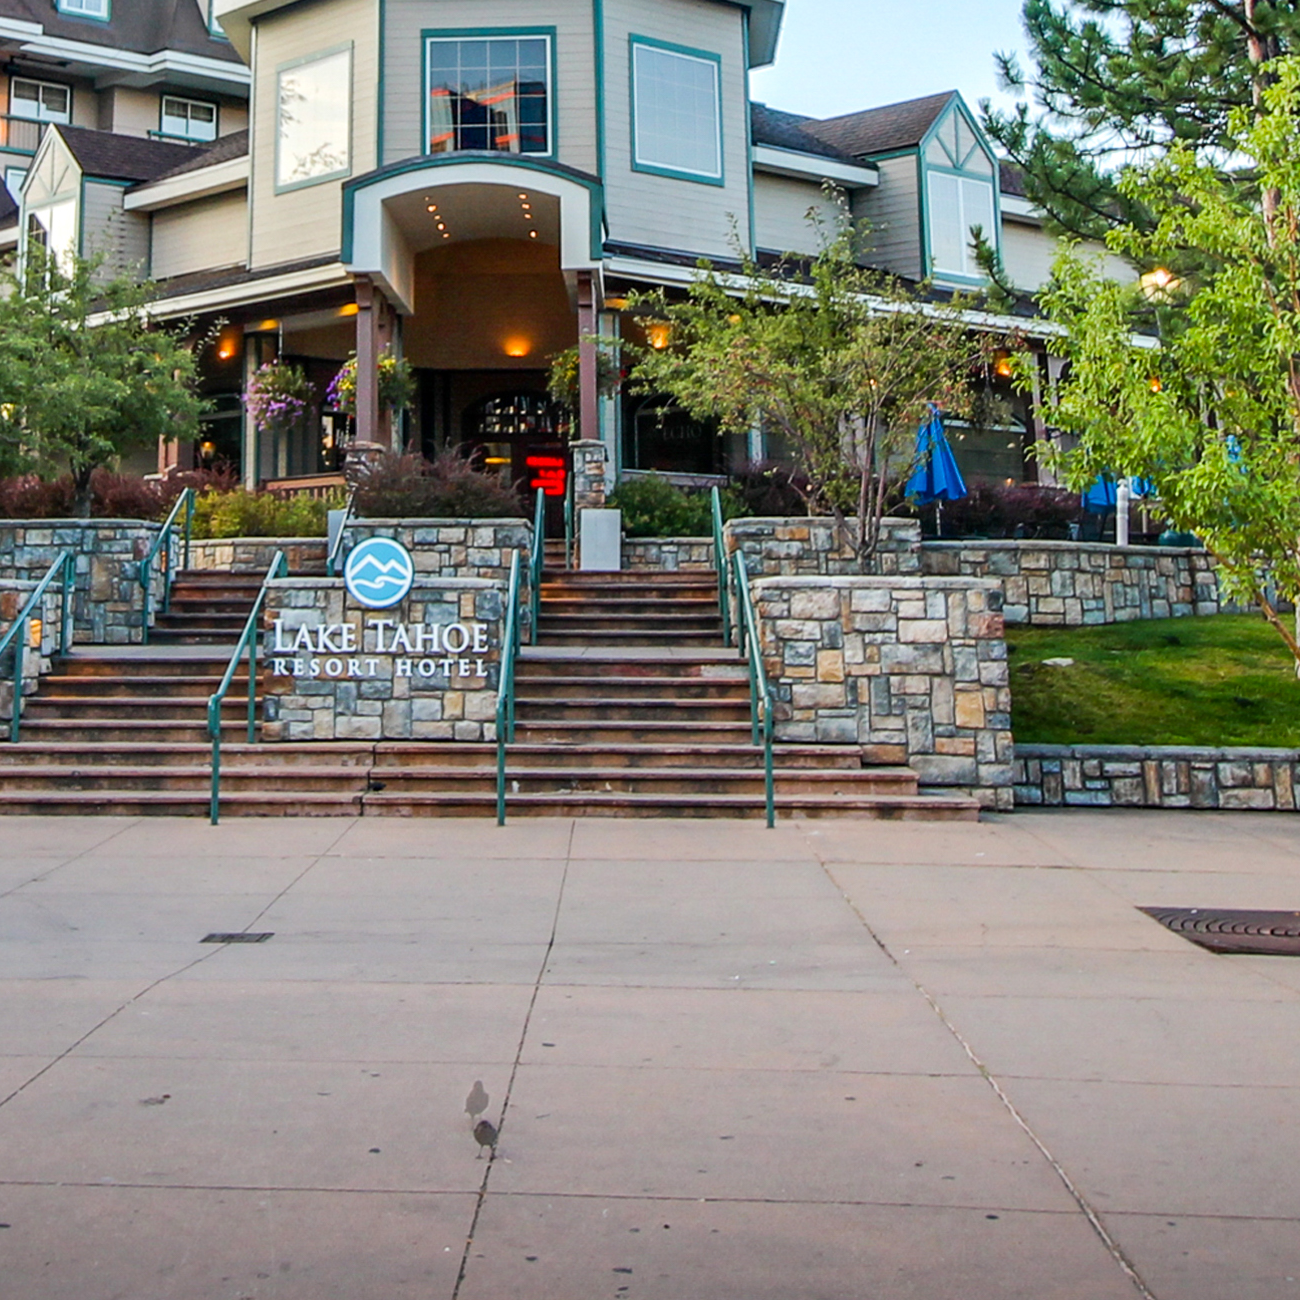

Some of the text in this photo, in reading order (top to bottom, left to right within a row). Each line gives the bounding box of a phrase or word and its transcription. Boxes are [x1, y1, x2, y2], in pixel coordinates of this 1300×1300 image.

[273, 619, 489, 654] LAKE TAHOE
[273, 658, 489, 677] RESORT HOTEL
